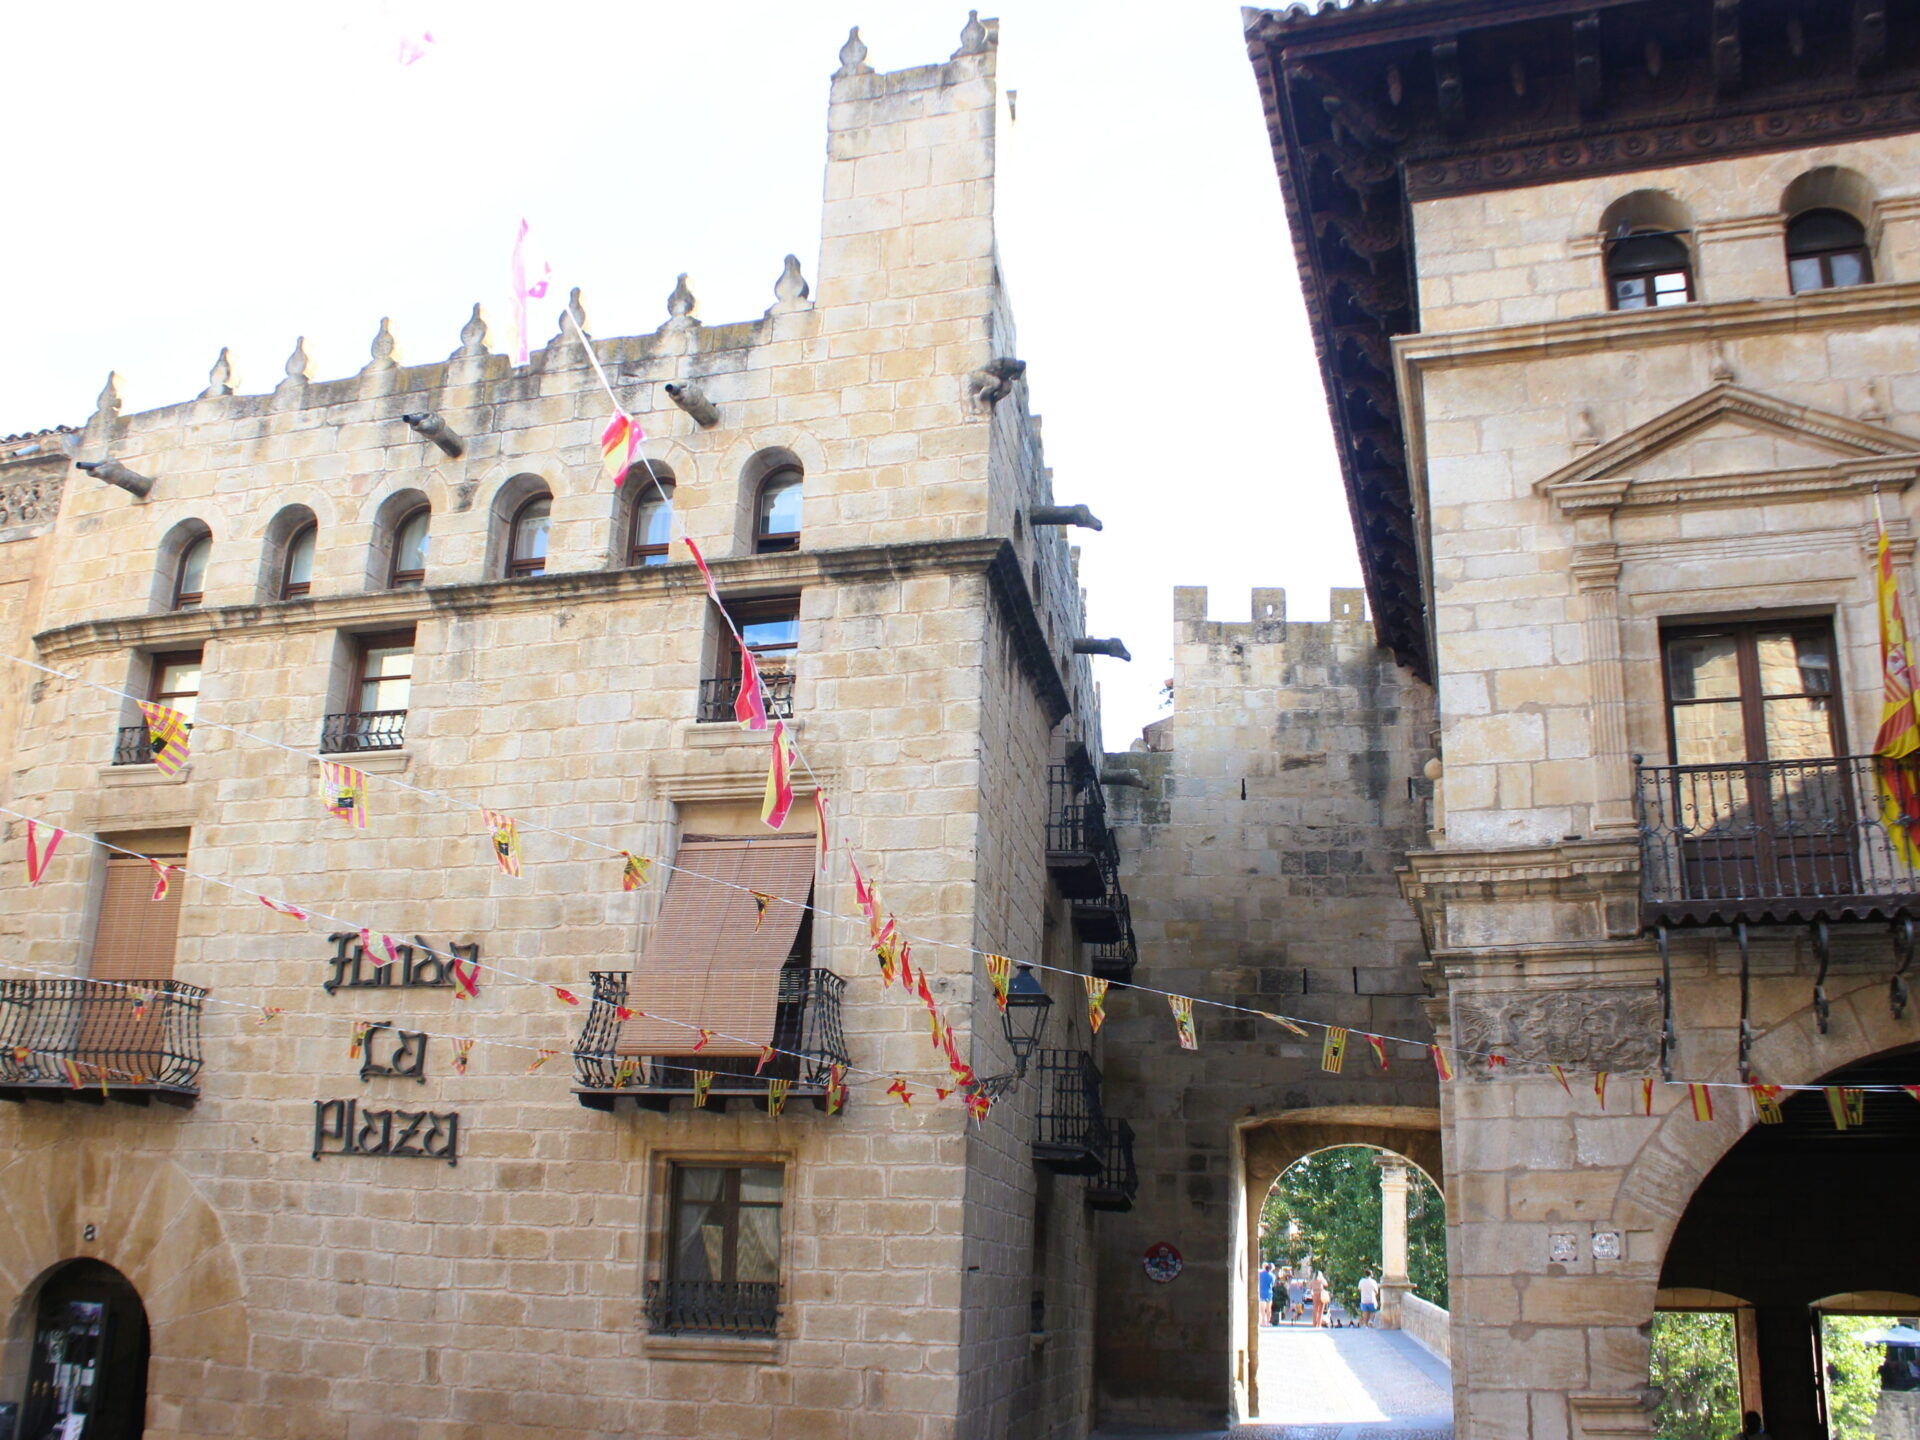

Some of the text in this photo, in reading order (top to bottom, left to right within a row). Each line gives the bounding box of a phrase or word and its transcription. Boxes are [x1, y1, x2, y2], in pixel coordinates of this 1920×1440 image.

[361, 1021, 427, 1081] La
[313, 1098, 459, 1161] Plaza
[84, 1224, 96, 1242] 8
